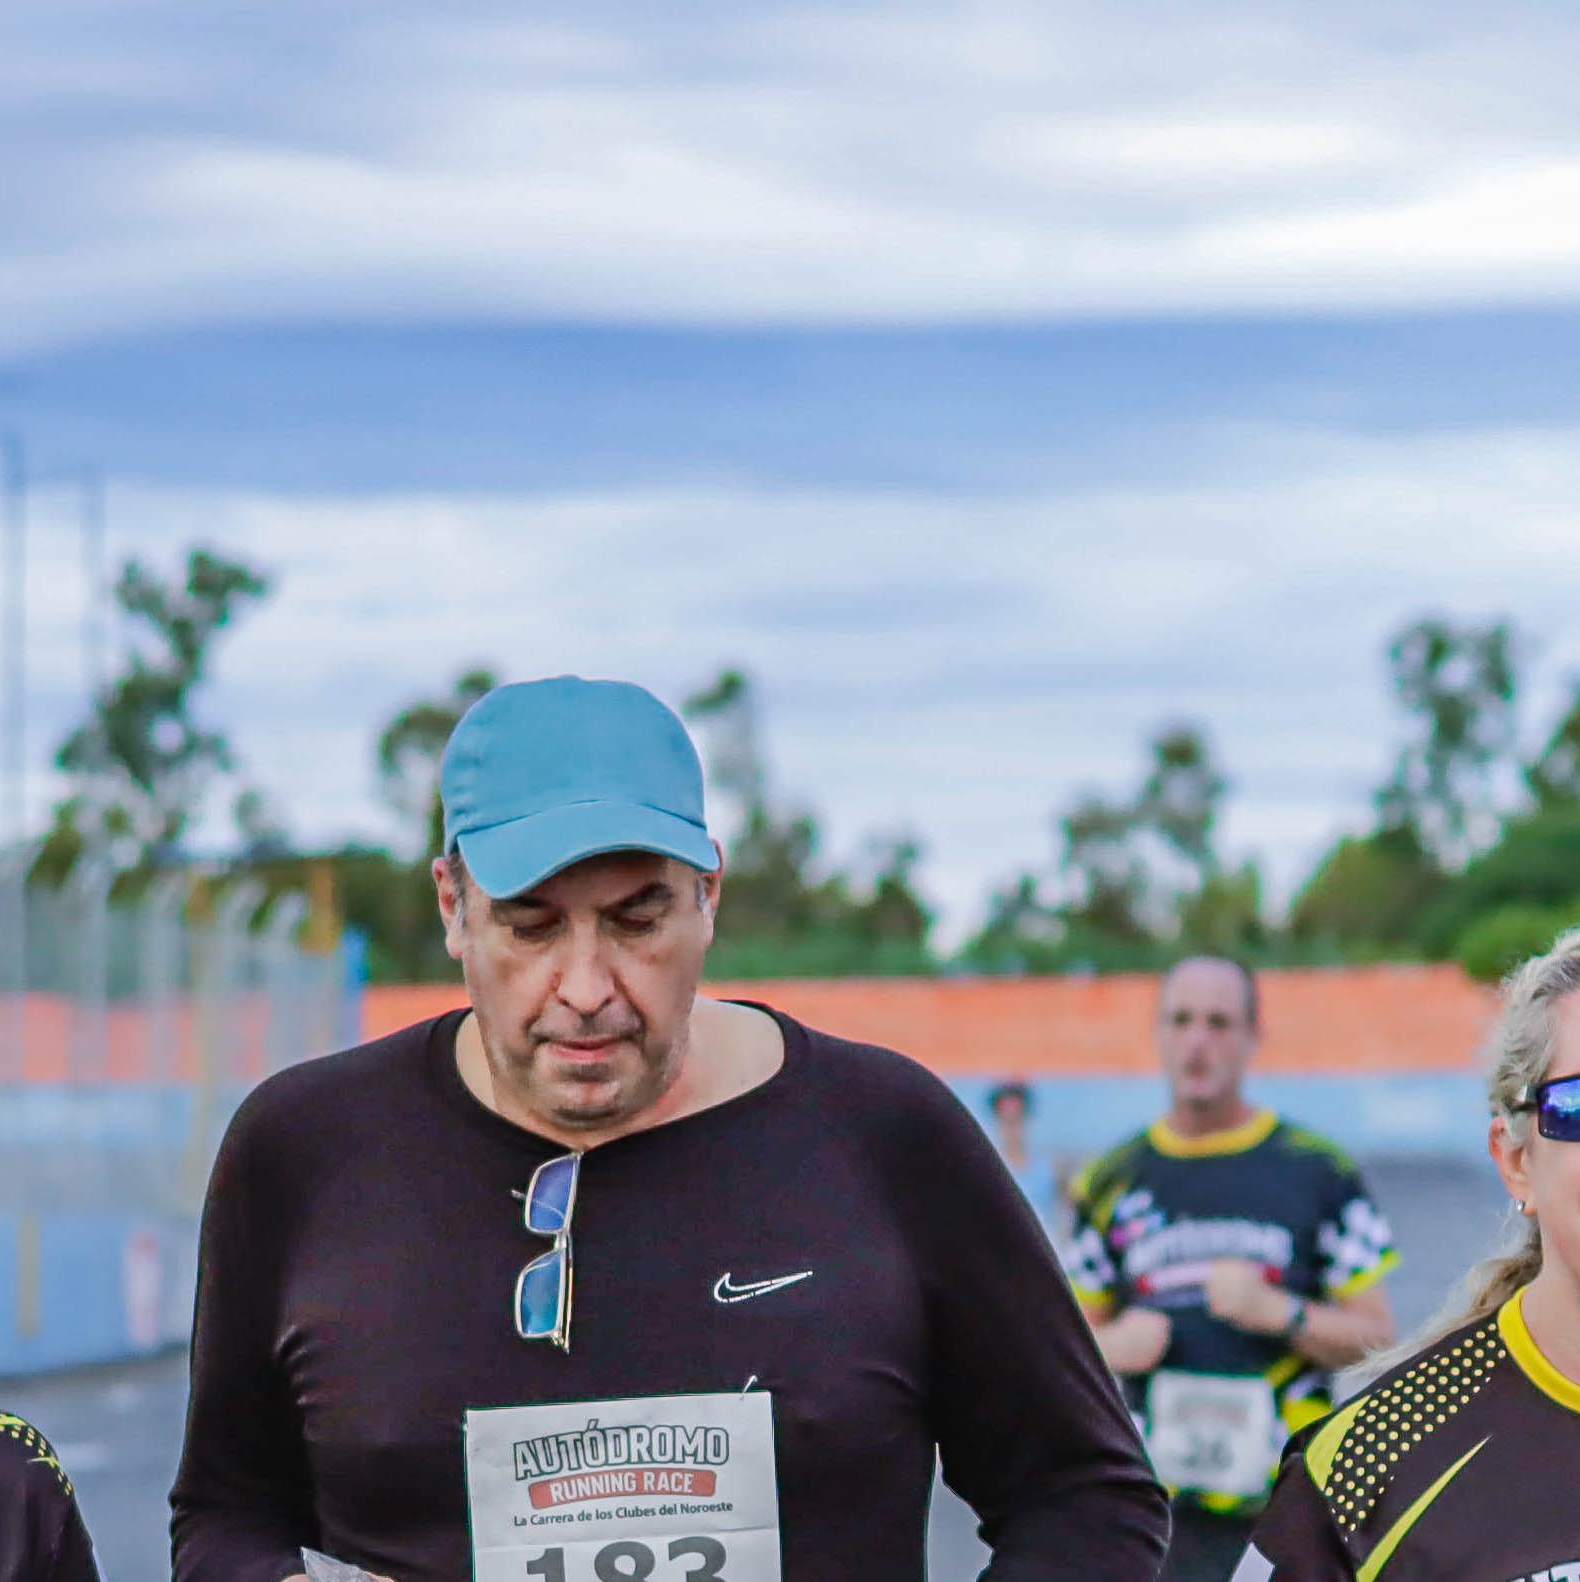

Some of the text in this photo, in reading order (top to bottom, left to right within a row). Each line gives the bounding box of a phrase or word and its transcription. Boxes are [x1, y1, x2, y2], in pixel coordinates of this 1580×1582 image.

[512, 1419, 730, 1481] AUTÓDROMO
[549, 1471, 694, 1504] RUNNING RACE
[513, 1501, 734, 1527] La Carrera de los Clubes del Noroeste
